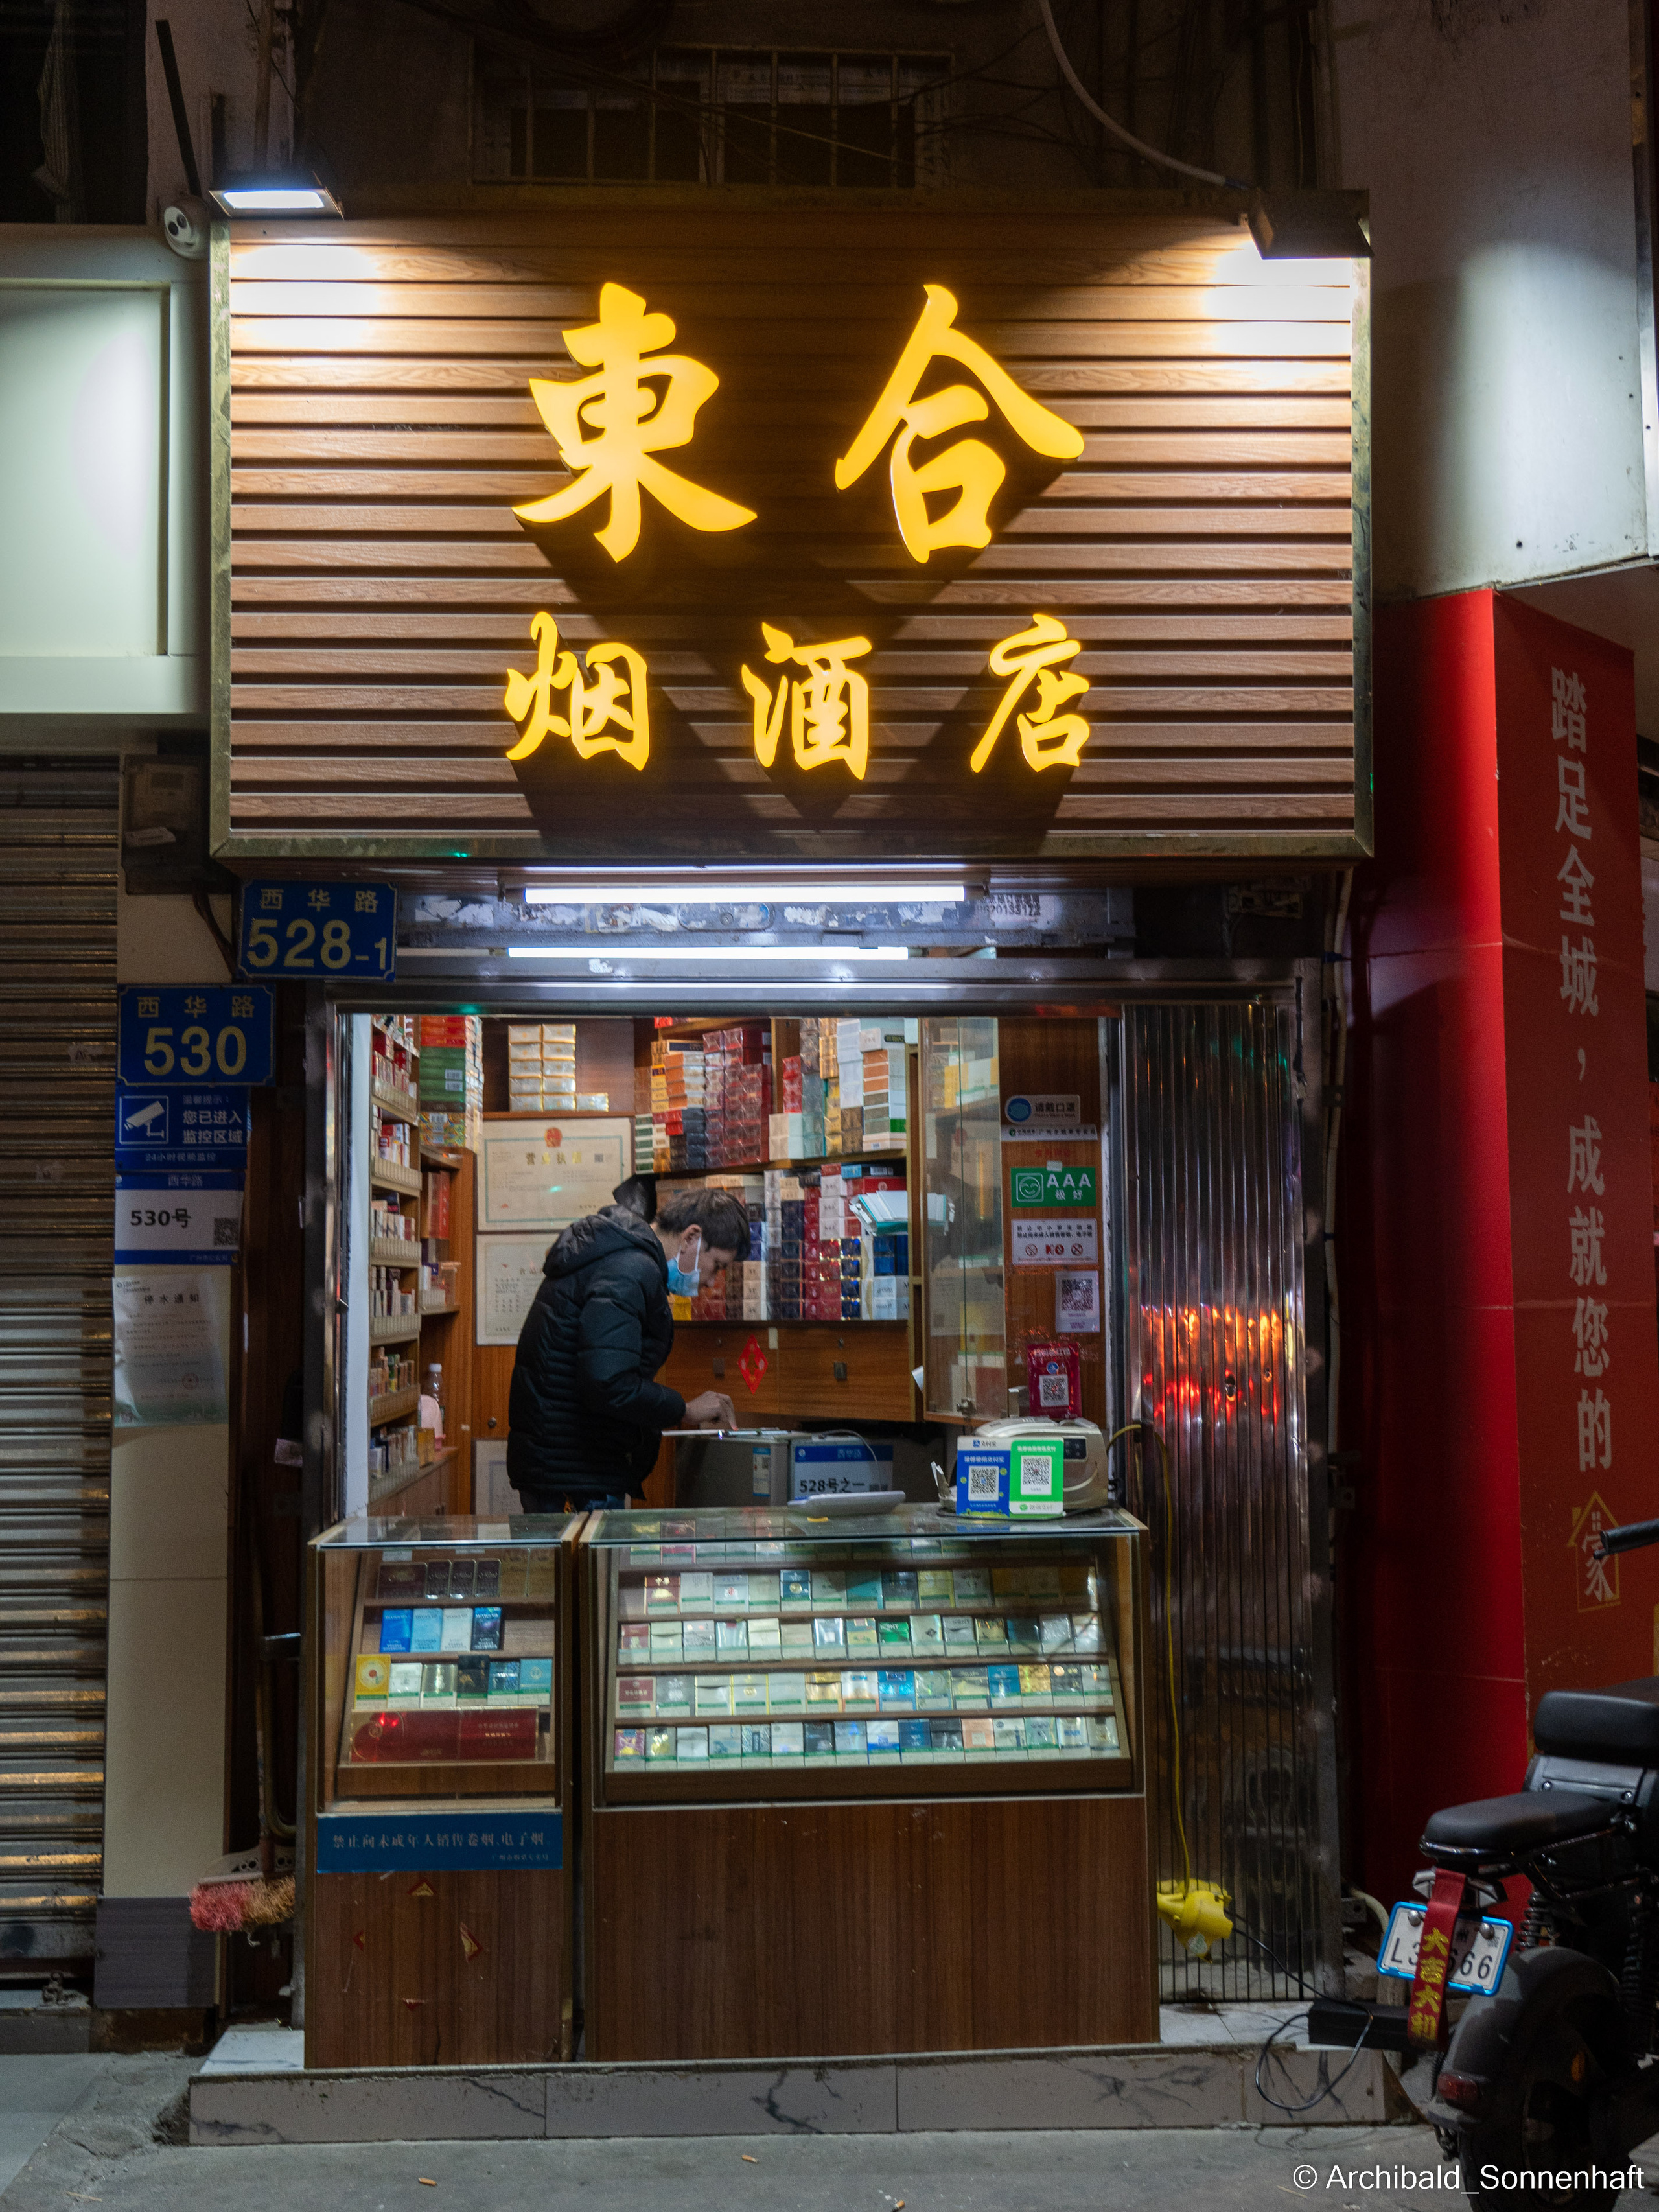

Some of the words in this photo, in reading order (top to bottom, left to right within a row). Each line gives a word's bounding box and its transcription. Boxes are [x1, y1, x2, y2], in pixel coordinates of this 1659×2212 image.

[511, 282, 1085, 564] 東合
[504, 611, 1090, 780] 烟酒店
[259, 888, 378, 913] 西华路
[247, 918, 387, 970] 528-1
[137, 995, 255, 1018] 西华路
[144, 1025, 247, 1076] 530
[183, 1110, 242, 1124] 您已进入
[1035, 1102, 1075, 1112] 请戴口罩
[183, 1130, 243, 1144] 监控区域
[168, 1174, 203, 1187] 西华路
[130, 1209, 191, 1228] 530号
[800, 1477, 865, 1493] 528号之一
[332, 1832, 544, 1848] 禁止向未成年人销售卷烟、电子烟
[1391, 1938, 1493, 1979] L366
[1410, 1927, 1449, 2040] 大吉大利
